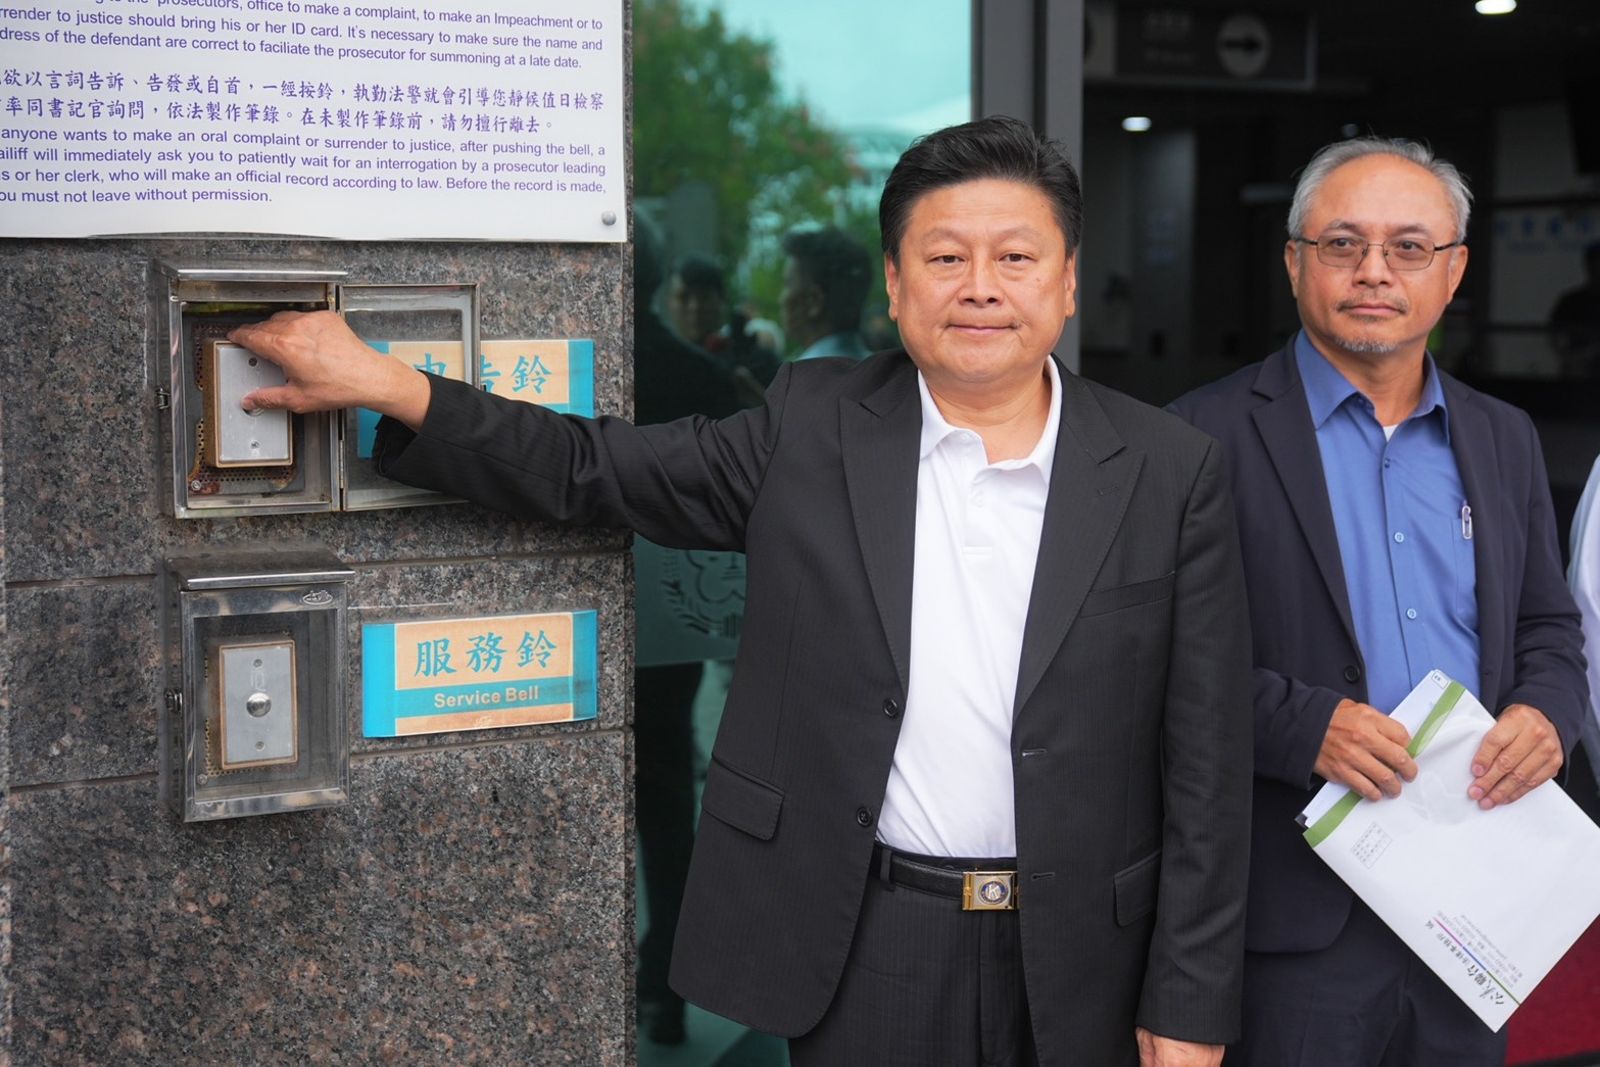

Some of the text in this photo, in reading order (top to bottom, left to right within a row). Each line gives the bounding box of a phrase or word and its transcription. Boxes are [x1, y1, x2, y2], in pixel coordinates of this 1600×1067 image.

[57, 10, 71, 22] to
[76, 10, 122, 26] justice
[128, 13, 175, 27] should
[181, 16, 216, 32] bring
[221, 18, 241, 31] his
[246, 22, 260, 32] or
[265, 20, 286, 34] her
[292, 22, 306, 35] ID
[311, 25, 342, 37] card.
[348, 25, 366, 38] It's
[371, 30, 434, 45] necessary
[439, 32, 450, 43] to
[456, 32, 488, 45] make
[492, 36, 518, 46] sure
[523, 36, 541, 47] the
[546, 40, 577, 49] name
[582, 40, 602, 50] and
[247, 0, 283, 12] office
[288, 1, 300, 13] to
[304, 2, 339, 15] make
[343, 7, 350, 16] a
[355, 6, 419, 21] complaint,
[424, 9, 435, 20] to
[439, 10, 472, 23] make
[476, 14, 490, 23] an
[495, 12, 573, 28] Impeachment
[577, 20, 588, 28] or
[592, 19, 602, 30] to
[0, 27, 581, 68] dress of the defendant are correct to faciliate the prosecutor for summoning at a late date.
[0, 68, 604, 111] 欲以言詞告訴、告發或自首，一經按鈴，執勤法警就會引導您靜候值日檢察
[0, 96, 552, 133] 率同書記官詢問，依法製作筆錄。在未製作筆錄前，請勿擅行離去。
[2, 129, 605, 156] anyone wants to make an oral complaint or surrender to justice, after pushing the bell, a
[33, 148, 58, 160] will
[64, 149, 152, 164] immediately
[158, 149, 182, 161] ask
[188, 152, 214, 164] you
[219, 150, 232, 162] to
[238, 152, 296, 168] patiently
[301, 155, 328, 167] wait
[333, 156, 350, 168] for
[356, 160, 371, 168] an
[377, 157, 457, 172] interrogation
[462, 159, 477, 174] by
[482, 162, 488, 171] a
[494, 162, 559, 174] prosecutor
[564, 162, 605, 176] leading
[15, 171, 31, 181] or
[36, 169, 60, 182] her
[65, 170, 104, 183] clerk,
[109, 169, 139, 181] who
[144, 168, 166, 180] will
[172, 169, 210, 181] make
[214, 172, 231, 181] an
[236, 170, 280, 183] official
[286, 175, 328, 186] record
[333, 176, 396, 191] according
[401, 178, 413, 188] to
[417, 177, 442, 188] law.
[446, 177, 487, 190] Before
[491, 179, 510, 190] the
[514, 180, 552, 191] record
[557, 180, 566, 191] is
[571, 181, 606, 193] made,
[22, 191, 59, 202] must
[64, 191, 88, 202] not
[92, 190, 130, 202] leave
[135, 188, 188, 200] without
[192, 189, 272, 202] permission.
[415, 630, 557, 677] 服務鈴
[434, 686, 539, 708] Service Bell
